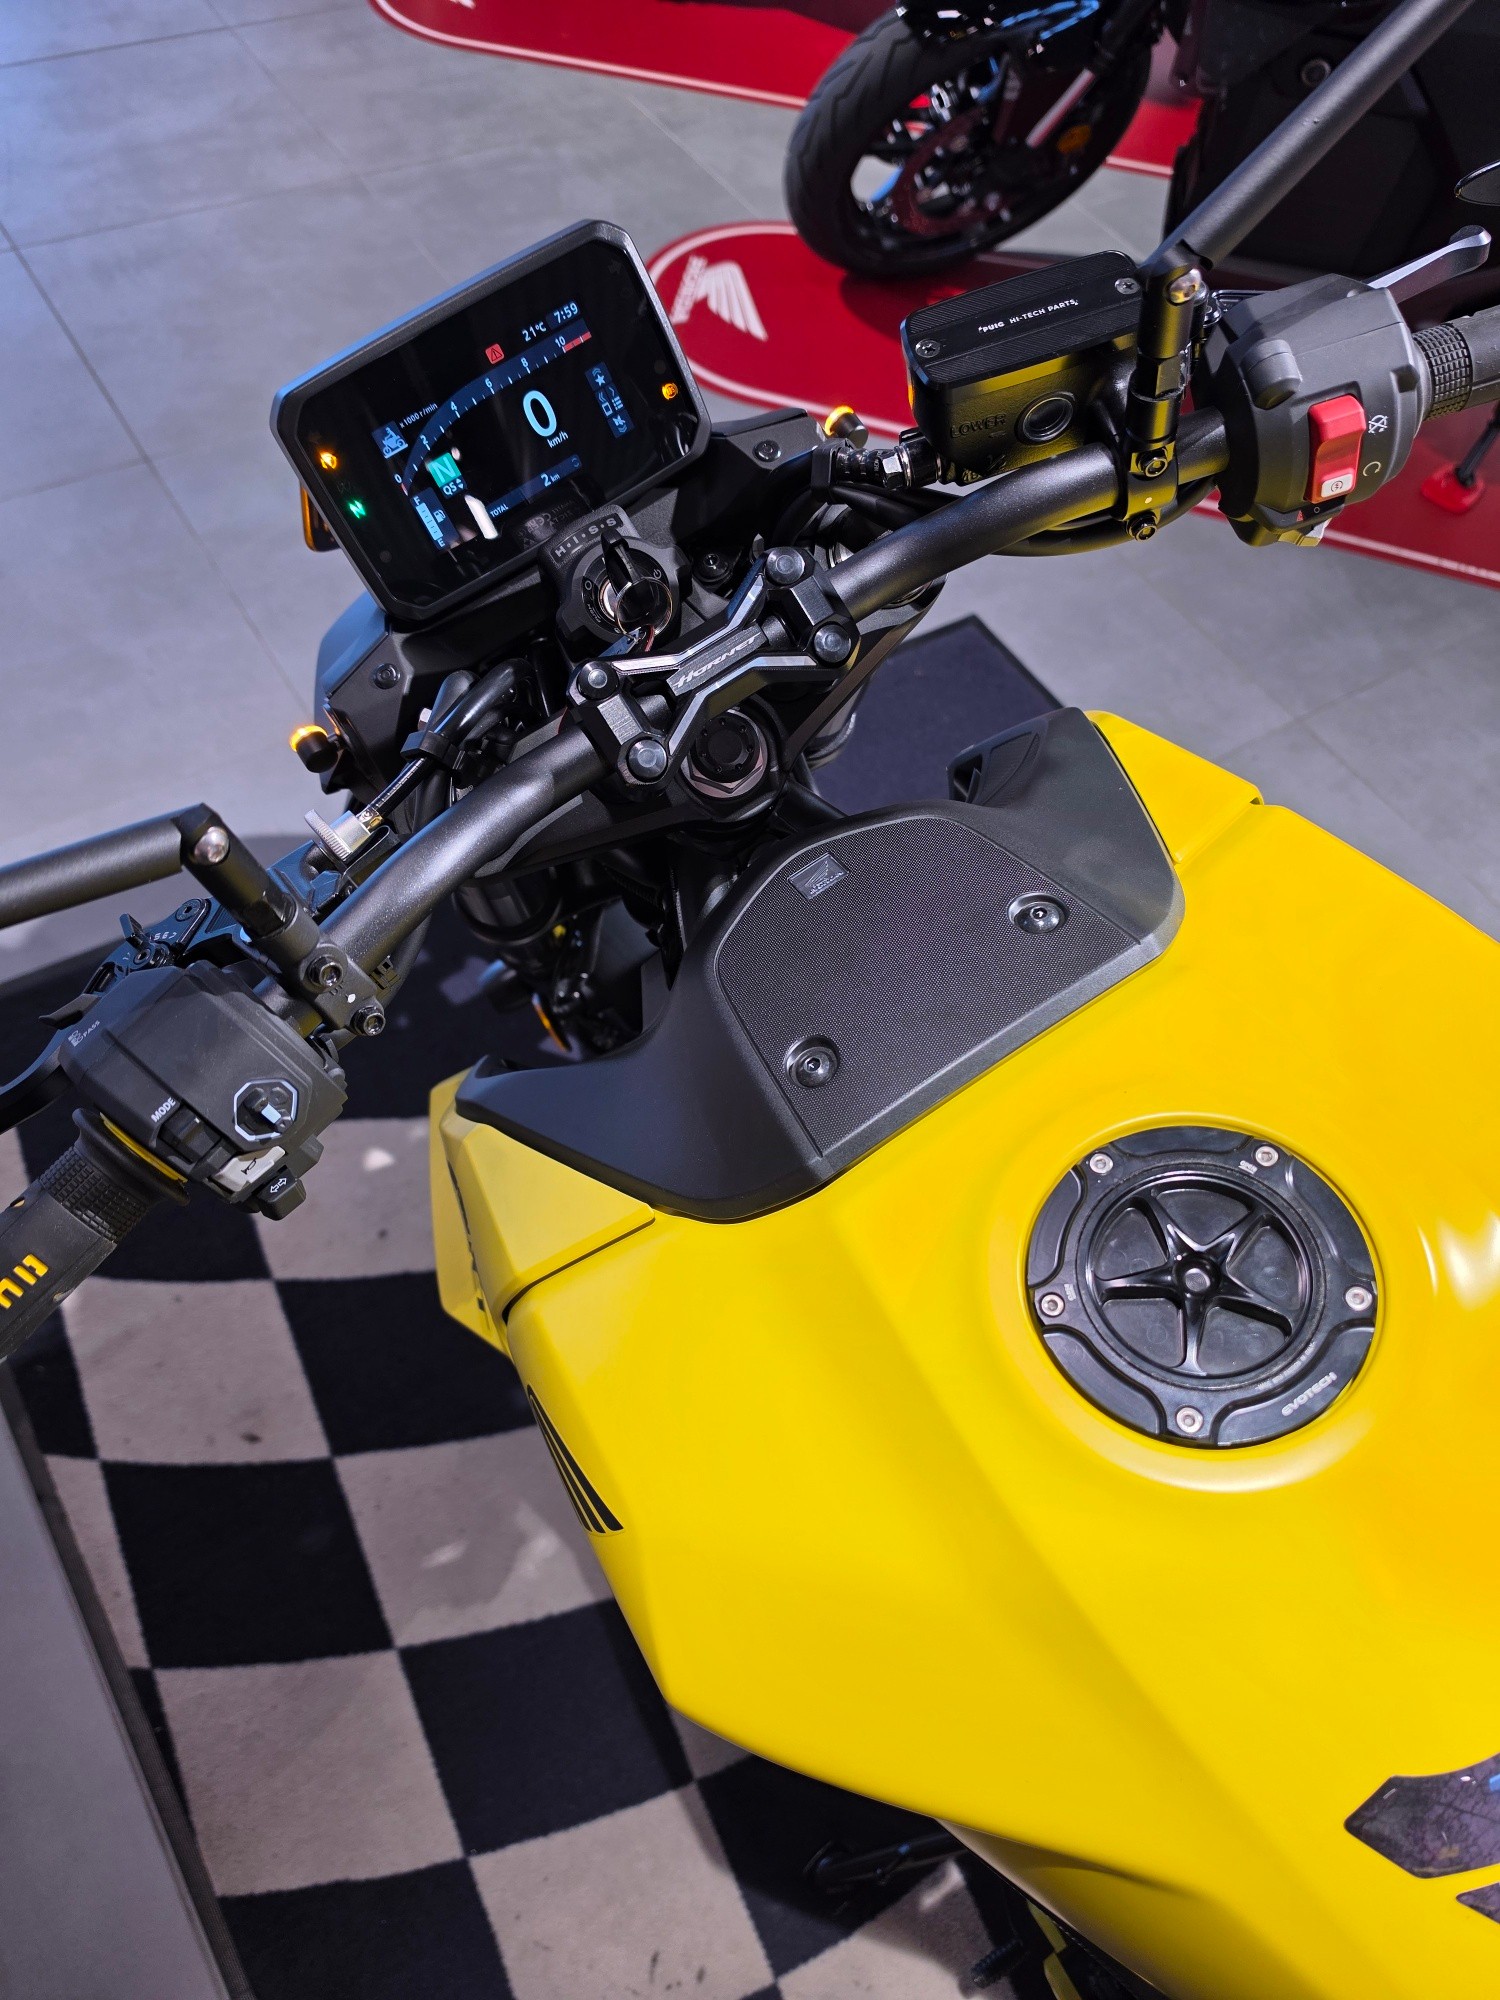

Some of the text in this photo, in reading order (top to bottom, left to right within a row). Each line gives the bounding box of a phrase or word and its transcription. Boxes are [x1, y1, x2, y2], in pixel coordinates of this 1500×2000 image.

[553, 302, 579, 323] 7:59
[982, 299, 1075, 333] PUIG HI-TECH PARTS
[555, 335, 566, 348] 10
[520, 356, 529, 368] 8
[484, 377, 493, 389] 6
[450, 401, 458, 411] 4
[522, 390, 557, 437] 0
[950, 413, 1006, 438] LOWER
[420, 434, 429, 445] 2
[547, 431, 569, 448] km/h
[431, 456, 457, 484] N
[394, 473, 403, 484] 0
[540, 473, 561, 487] 2 km
[442, 481, 458, 496] QS
[413, 495, 421, 506] F
[490, 503, 509, 518] TOTAL
[437, 537, 446, 548] E
[151, 1096, 176, 1122] MODE
